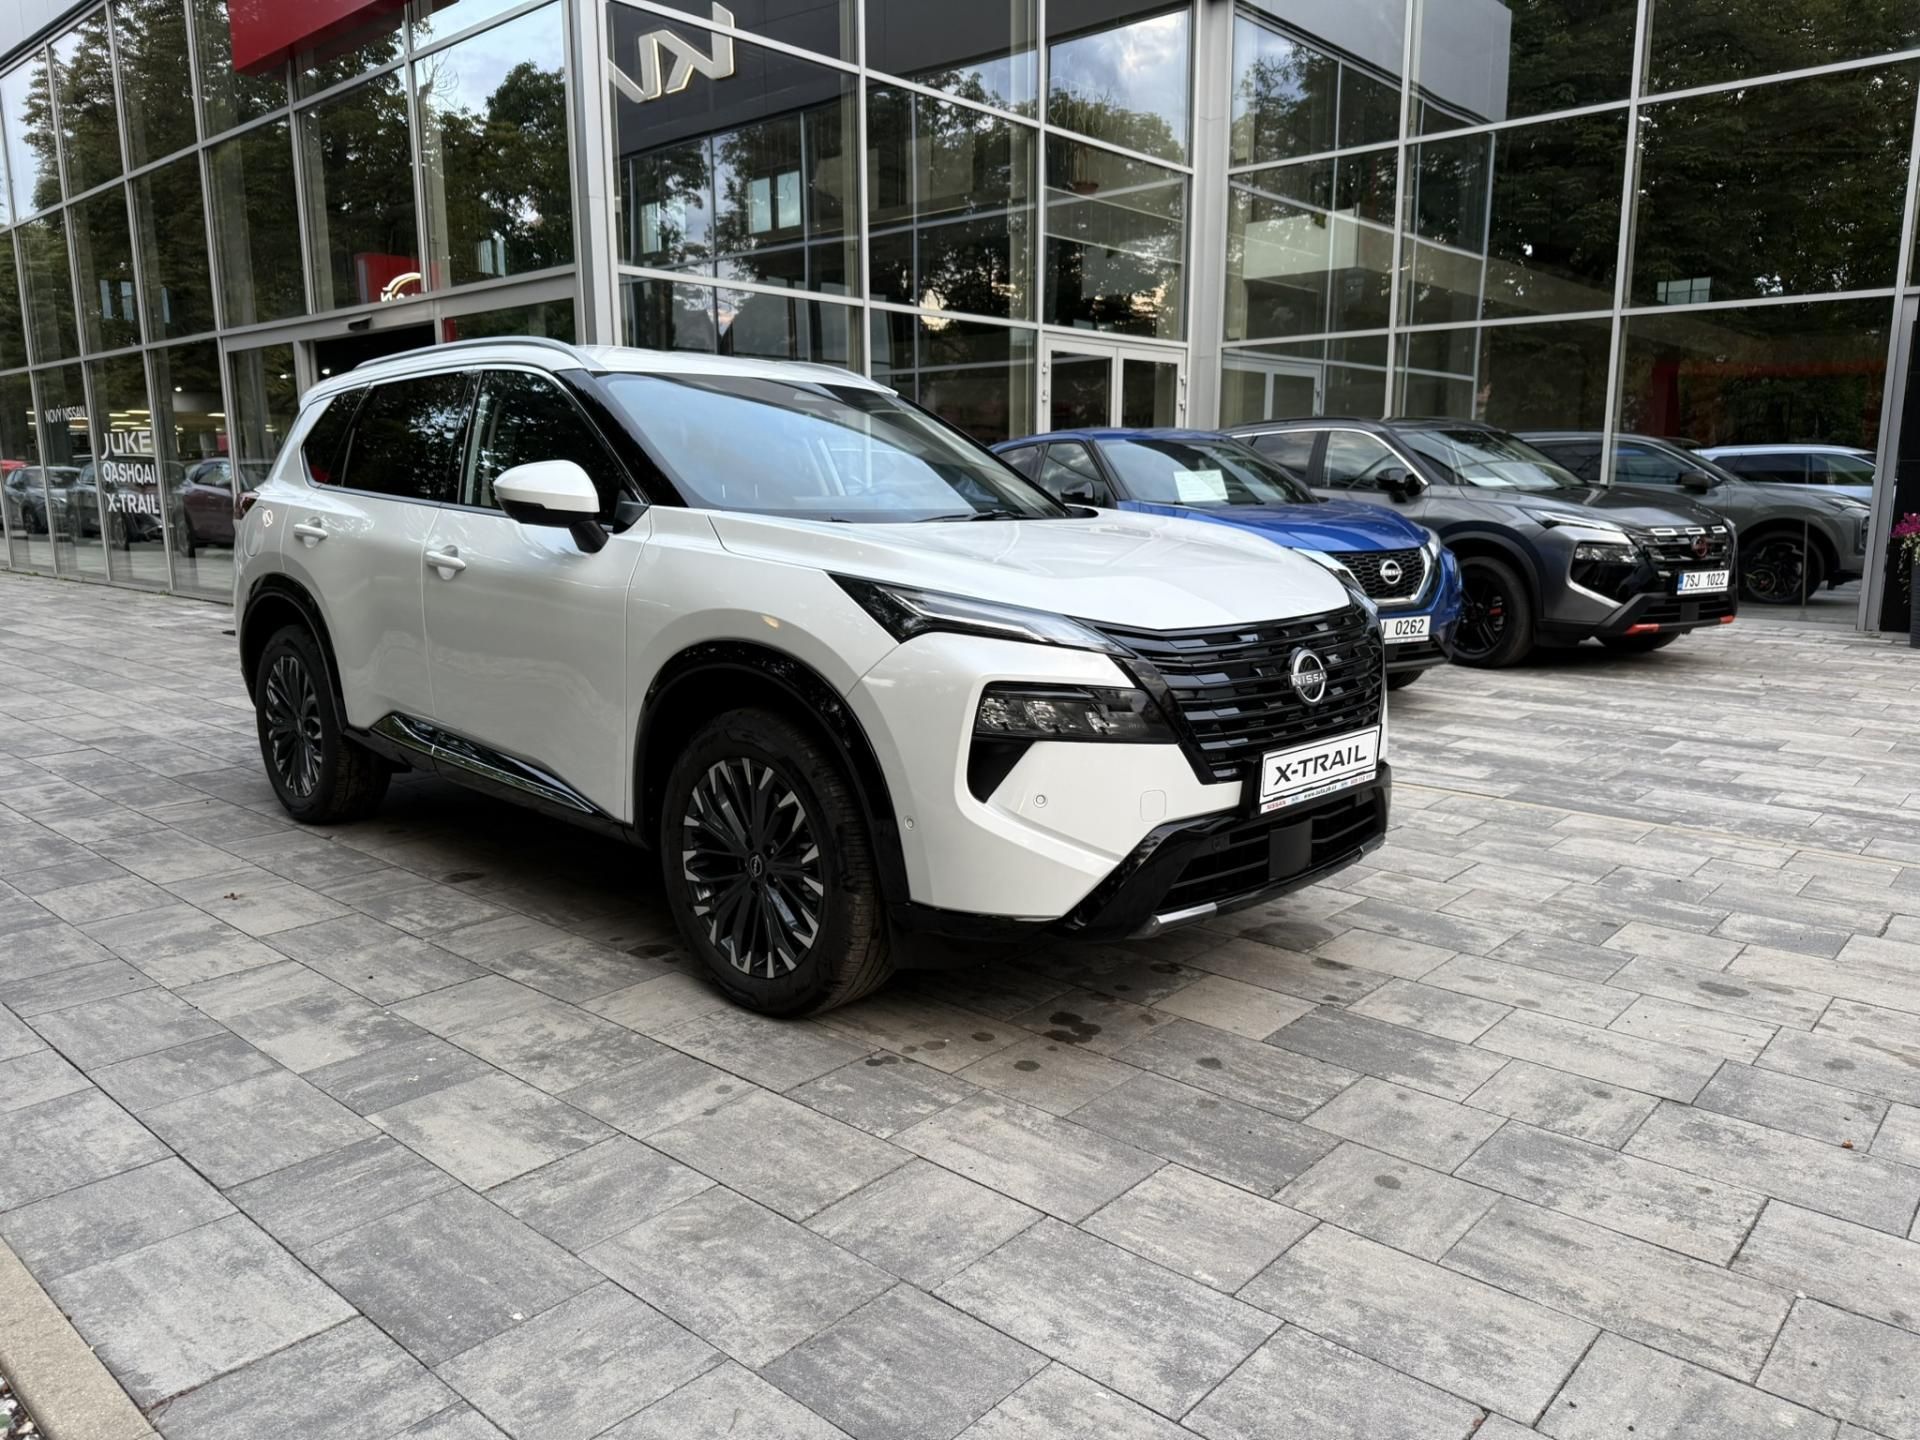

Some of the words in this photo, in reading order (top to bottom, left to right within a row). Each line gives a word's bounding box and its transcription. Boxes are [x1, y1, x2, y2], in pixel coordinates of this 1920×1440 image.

[45, 404, 62, 423] NOVÝ
[62, 405, 86, 421] NISSAN
[101, 431, 154, 460] JUKE
[102, 463, 156, 485] QASHQAI
[106, 493, 160, 514] X-TRAIL
[1684, 574, 1701, 588] 7SJ
[1706, 573, 1726, 587] 1022
[1395, 618, 1425, 635] 0262
[1291, 672, 1327, 686] NISSA
[1273, 745, 1367, 786] X-TRAIL
